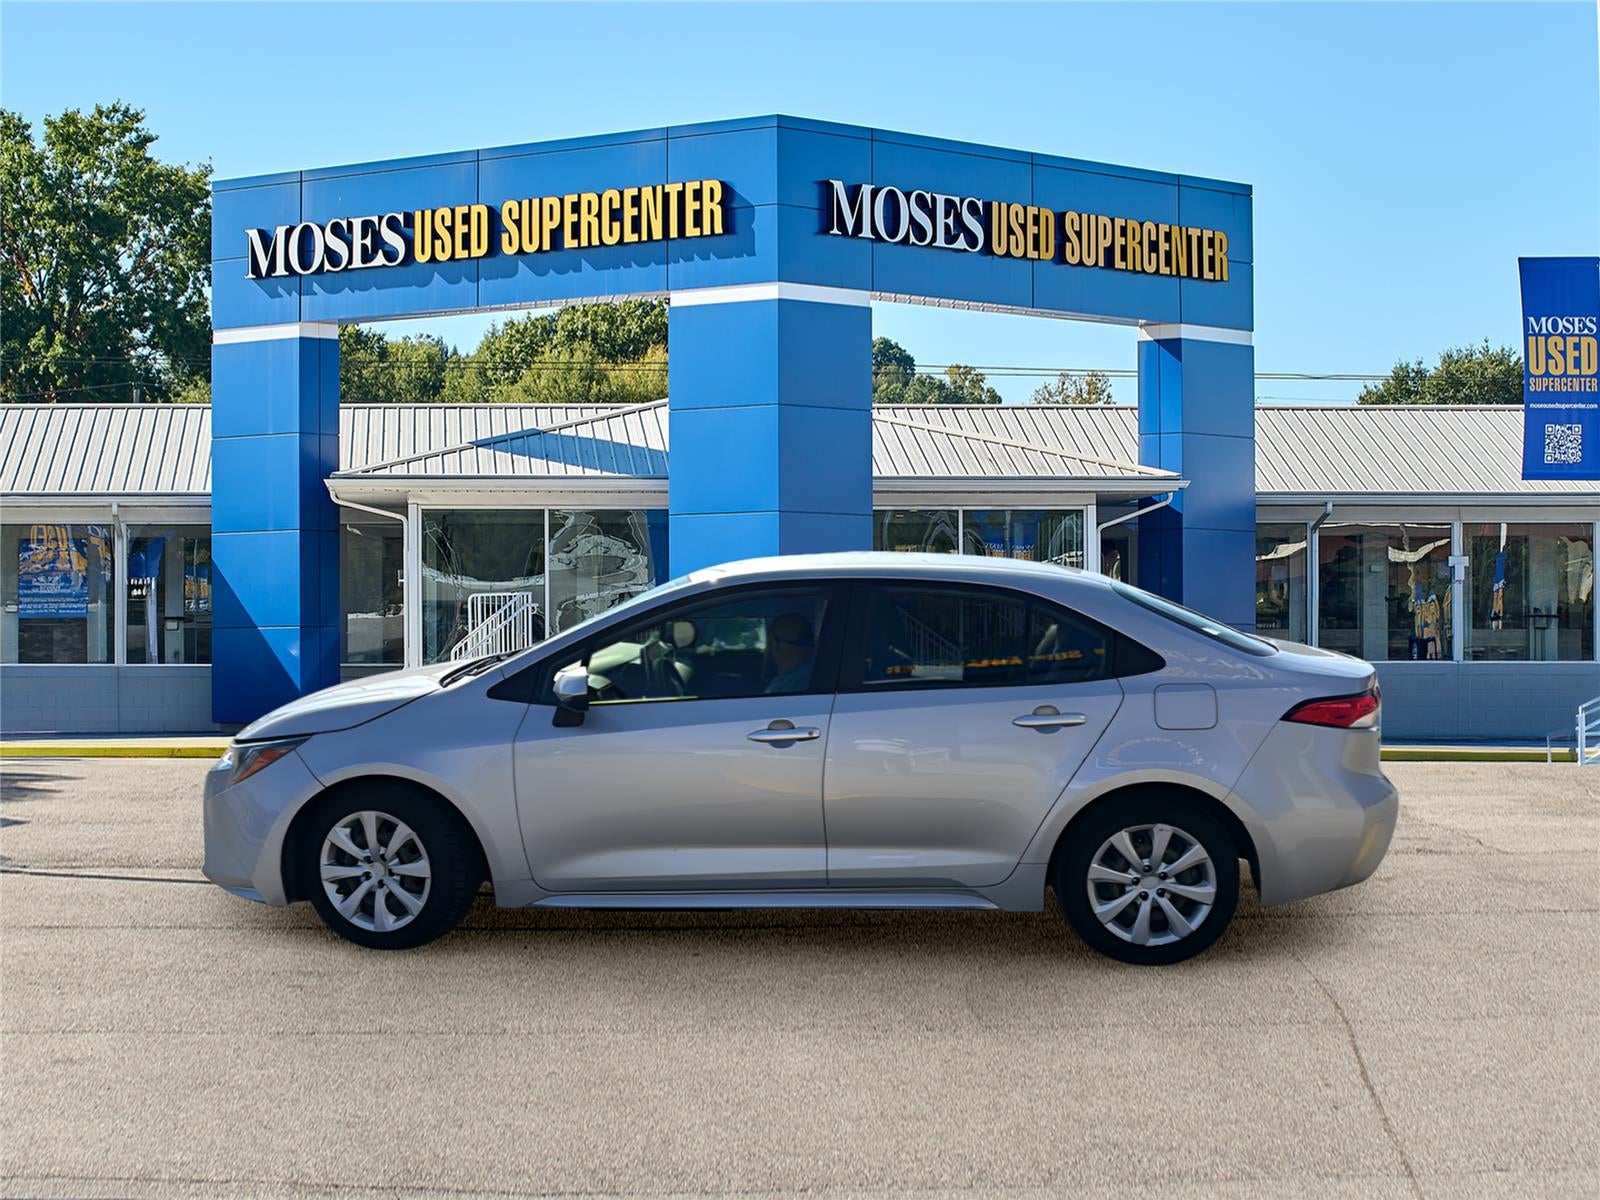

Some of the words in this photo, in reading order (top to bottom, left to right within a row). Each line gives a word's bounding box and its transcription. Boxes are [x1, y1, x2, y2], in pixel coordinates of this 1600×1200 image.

[245, 212, 407, 279] MOSES
[414, 204, 488, 263] USED
[502, 179, 724, 255] SUPERCENTER
[828, 179, 984, 252] MOSES
[992, 201, 1055, 261] USED
[1065, 211, 1229, 281] SUPERCENTER
[1528, 317, 1597, 334] MOSES
[1528, 336, 1598, 375] USED
[1529, 377, 1598, 392] SUPERCENTER
